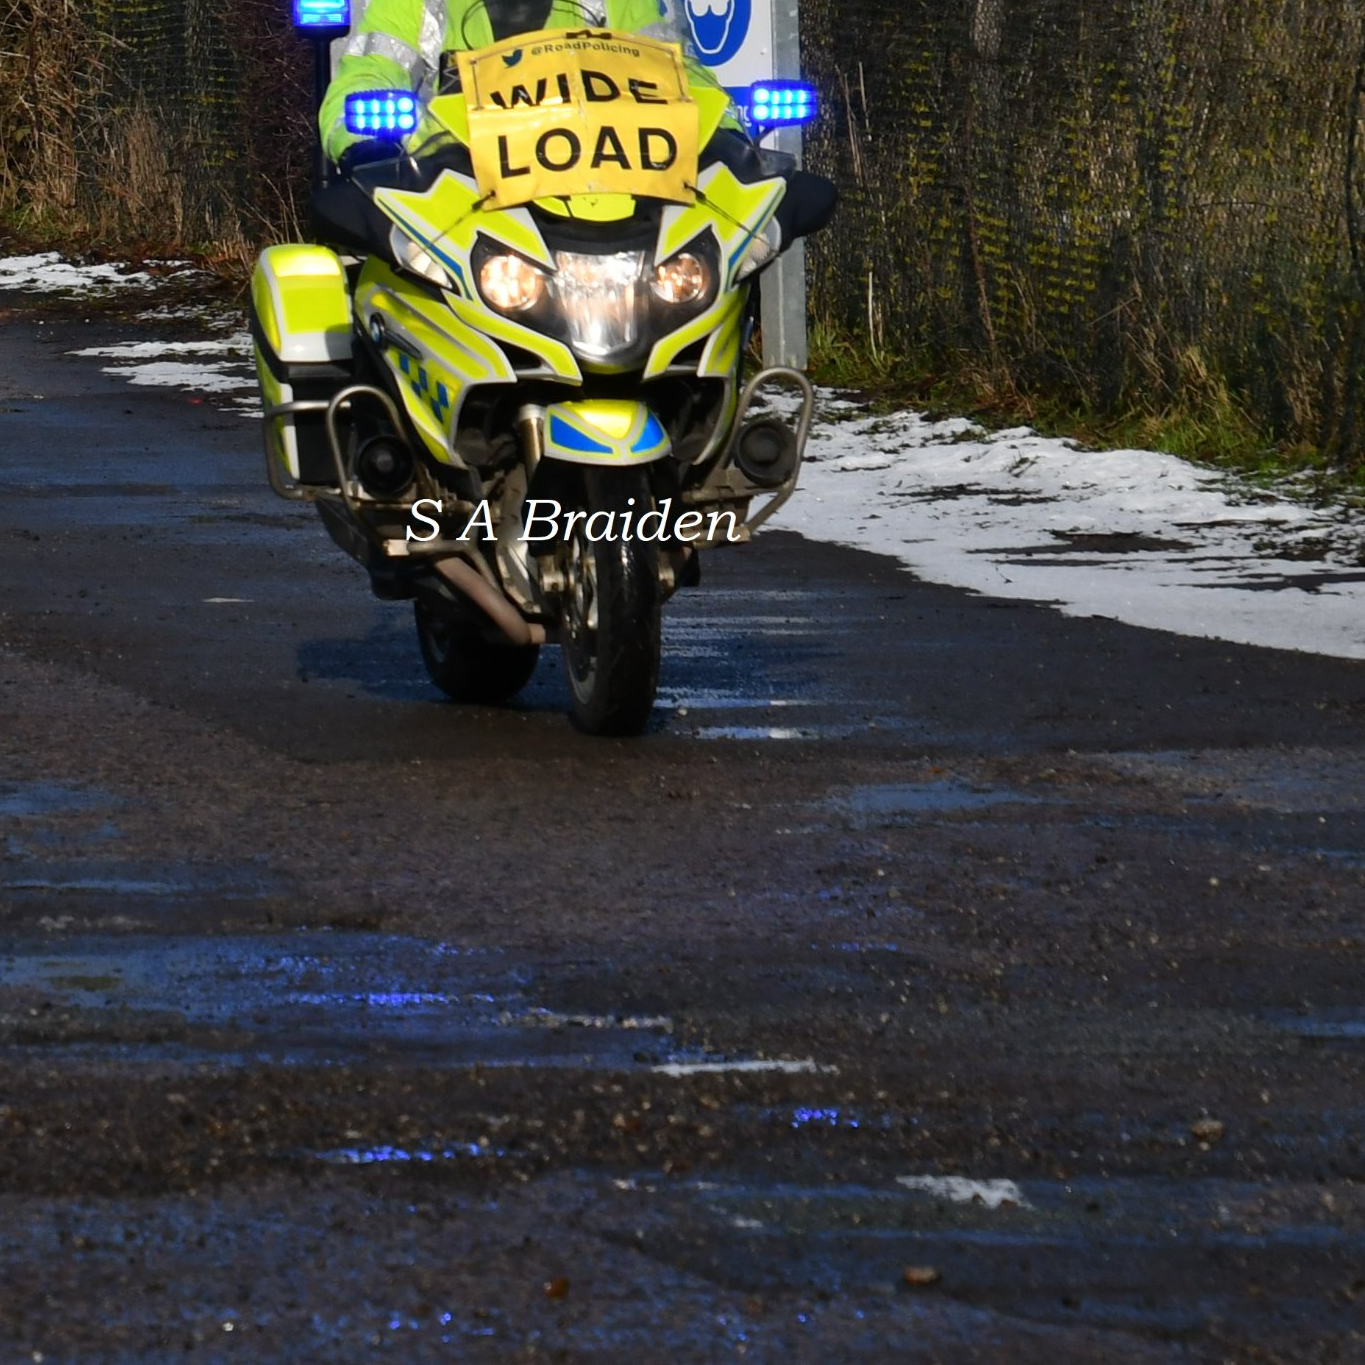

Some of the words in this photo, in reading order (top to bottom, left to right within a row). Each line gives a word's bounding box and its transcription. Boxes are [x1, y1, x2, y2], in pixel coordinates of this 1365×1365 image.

[531, 41, 641, 57] @RoadPolicing
[490, 68, 669, 111] WIDE
[496, 125, 679, 180] LOAD
